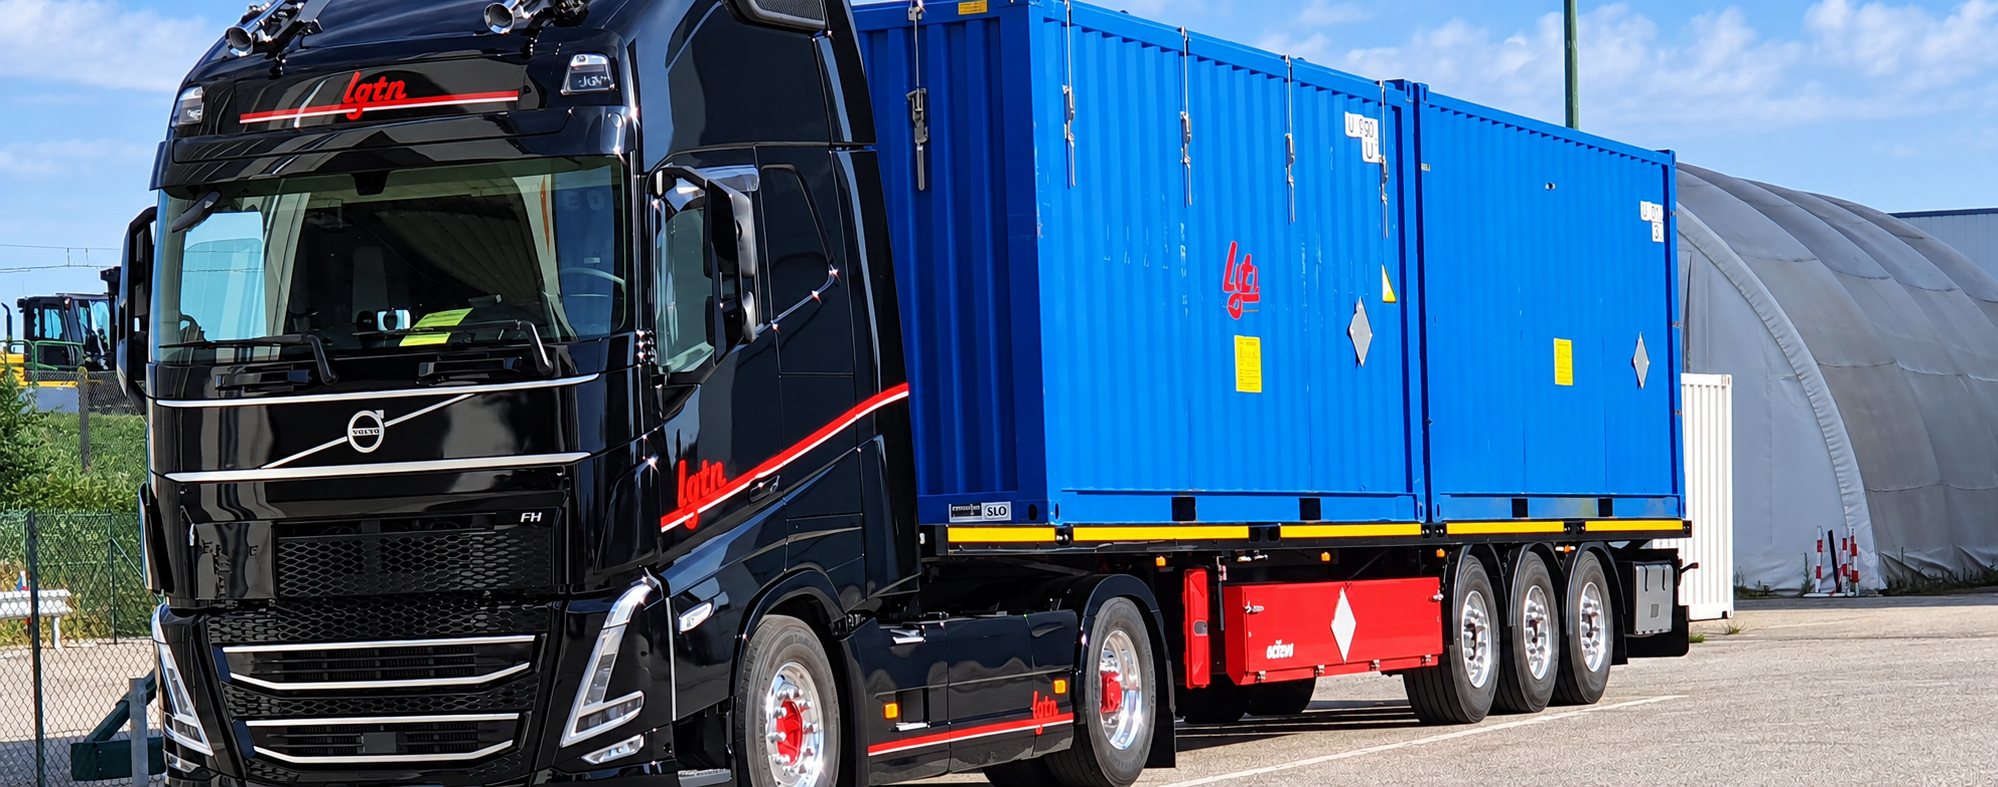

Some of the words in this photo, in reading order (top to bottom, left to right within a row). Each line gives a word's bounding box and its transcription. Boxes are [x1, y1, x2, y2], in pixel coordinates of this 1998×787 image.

[342, 70, 407, 120] lgtn
[677, 459, 727, 530] lgtn
[520, 511, 542, 523] FH
[986, 505, 1008, 517] SLO
